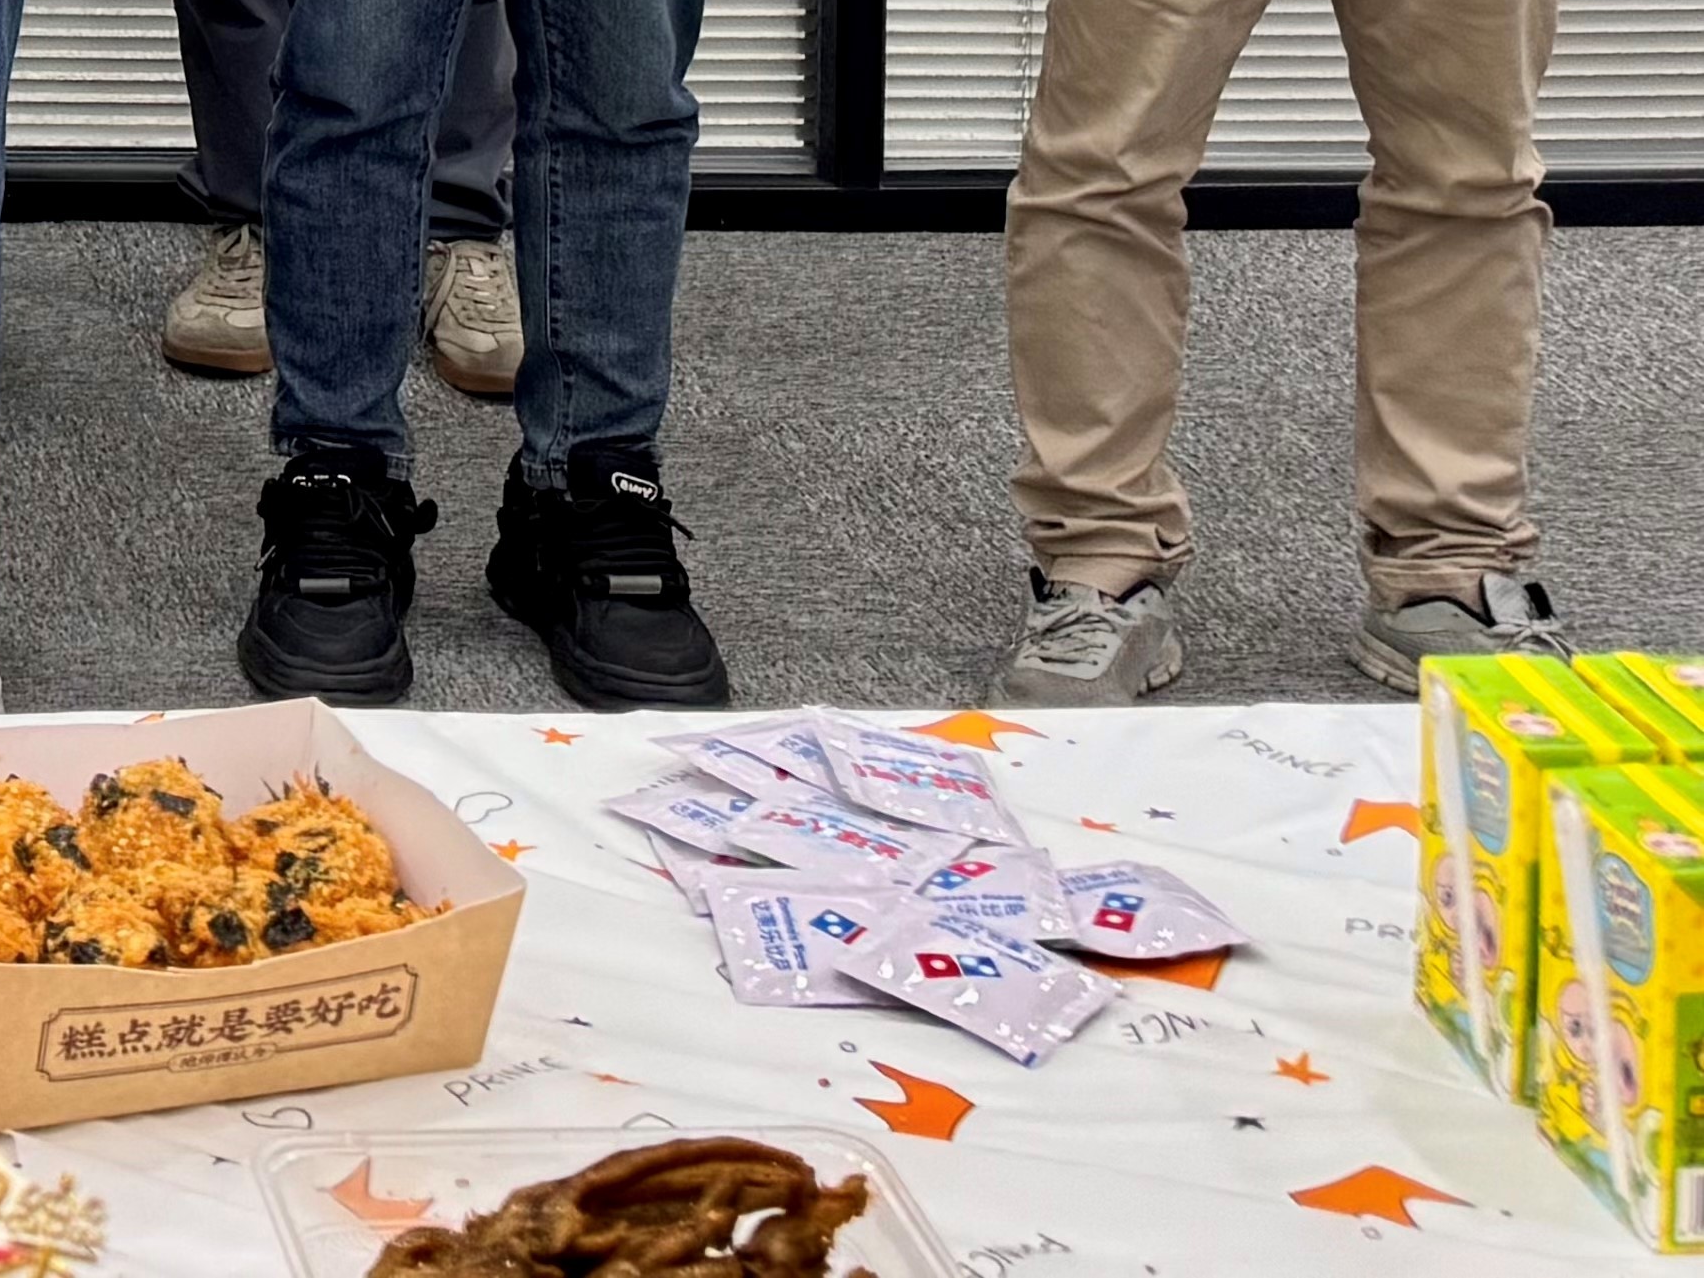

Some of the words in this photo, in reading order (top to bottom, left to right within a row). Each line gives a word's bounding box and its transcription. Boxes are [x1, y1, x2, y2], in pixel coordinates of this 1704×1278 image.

[1217, 728, 1356, 778] PRINCE
[57, 982, 402, 1061] 糕点就是要好吃
